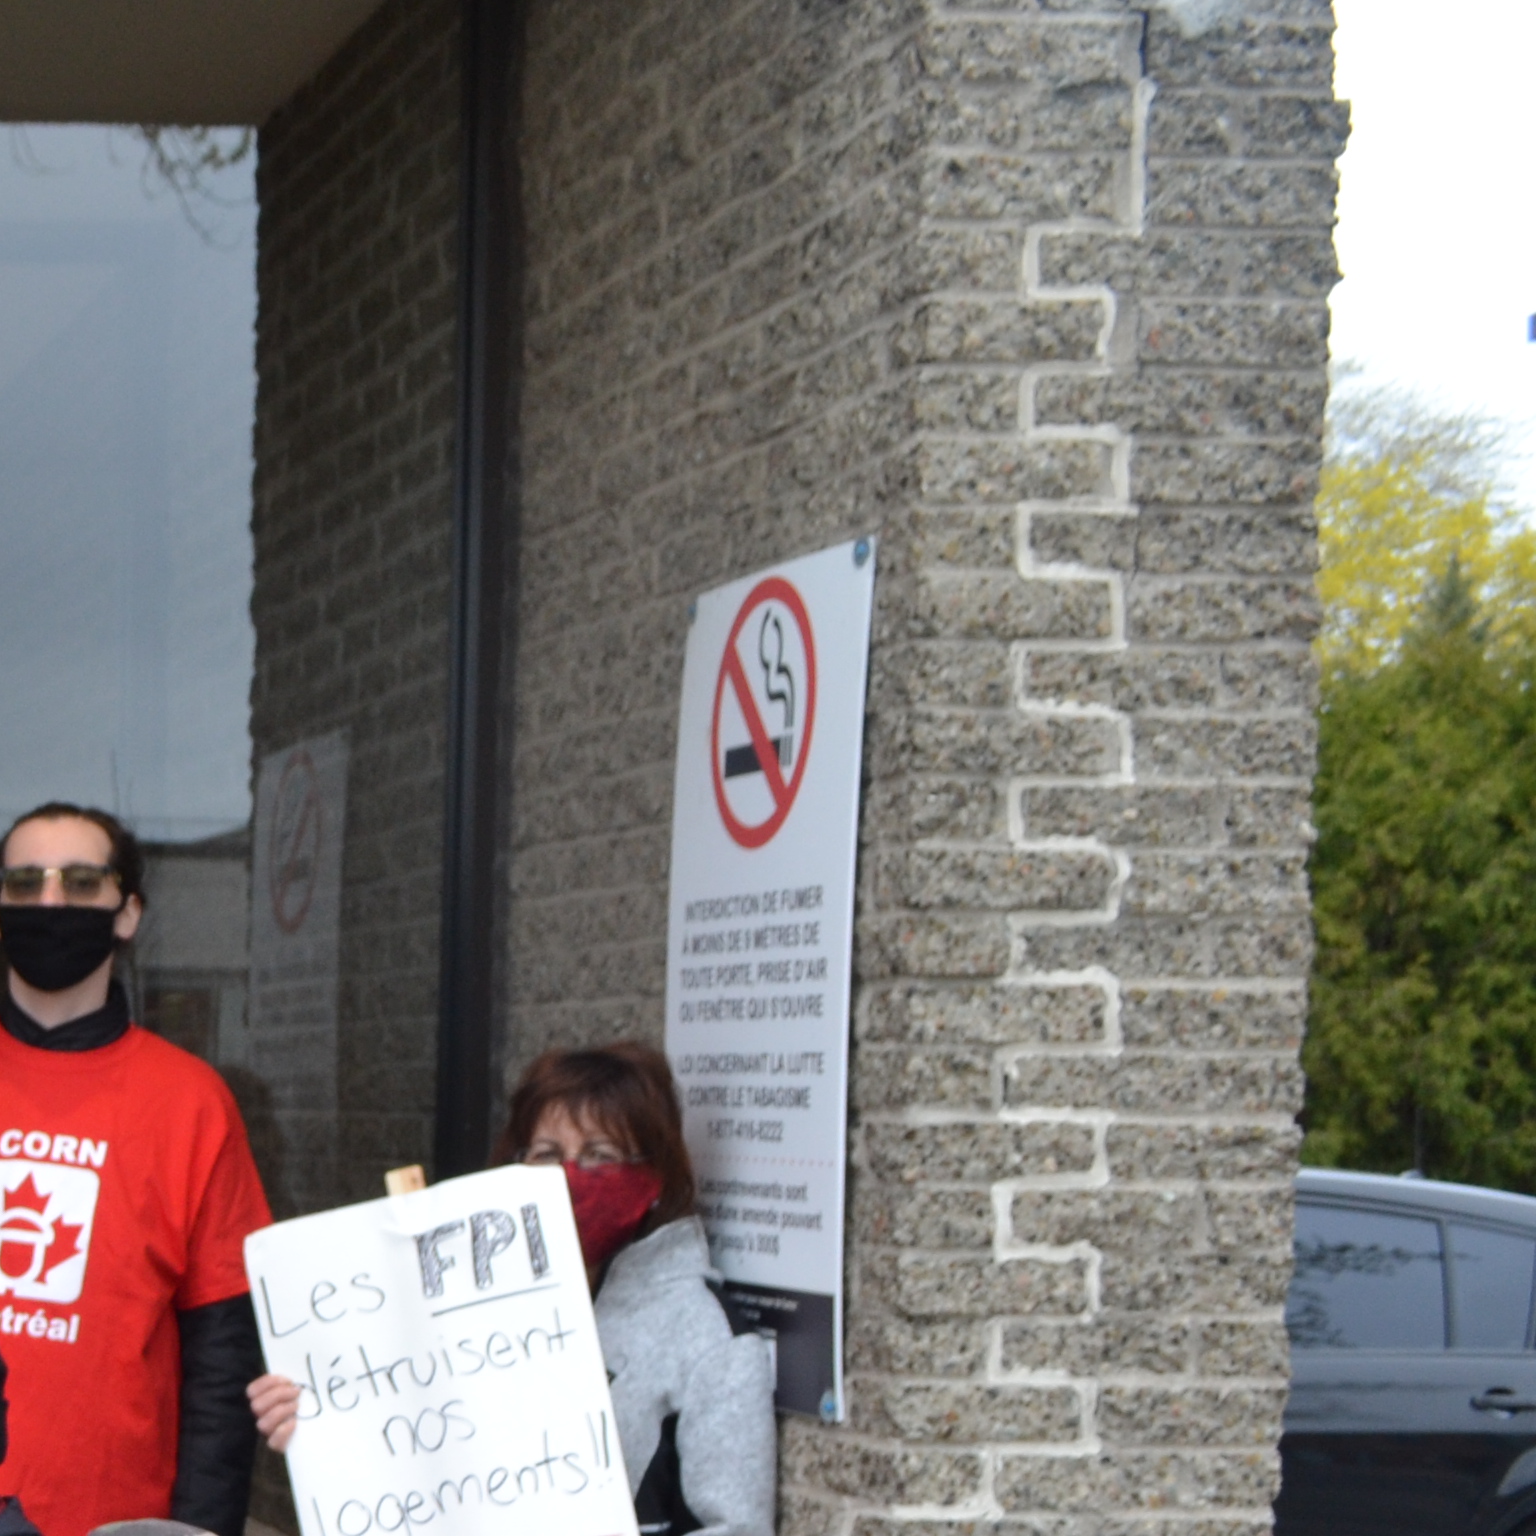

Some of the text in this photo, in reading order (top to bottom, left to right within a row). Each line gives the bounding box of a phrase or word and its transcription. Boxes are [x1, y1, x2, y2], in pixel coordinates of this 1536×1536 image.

[259, 1203, 552, 1339] Les FPI
[293, 1307, 576, 1420] détruisent
[382, 1399, 476, 1455] nos
